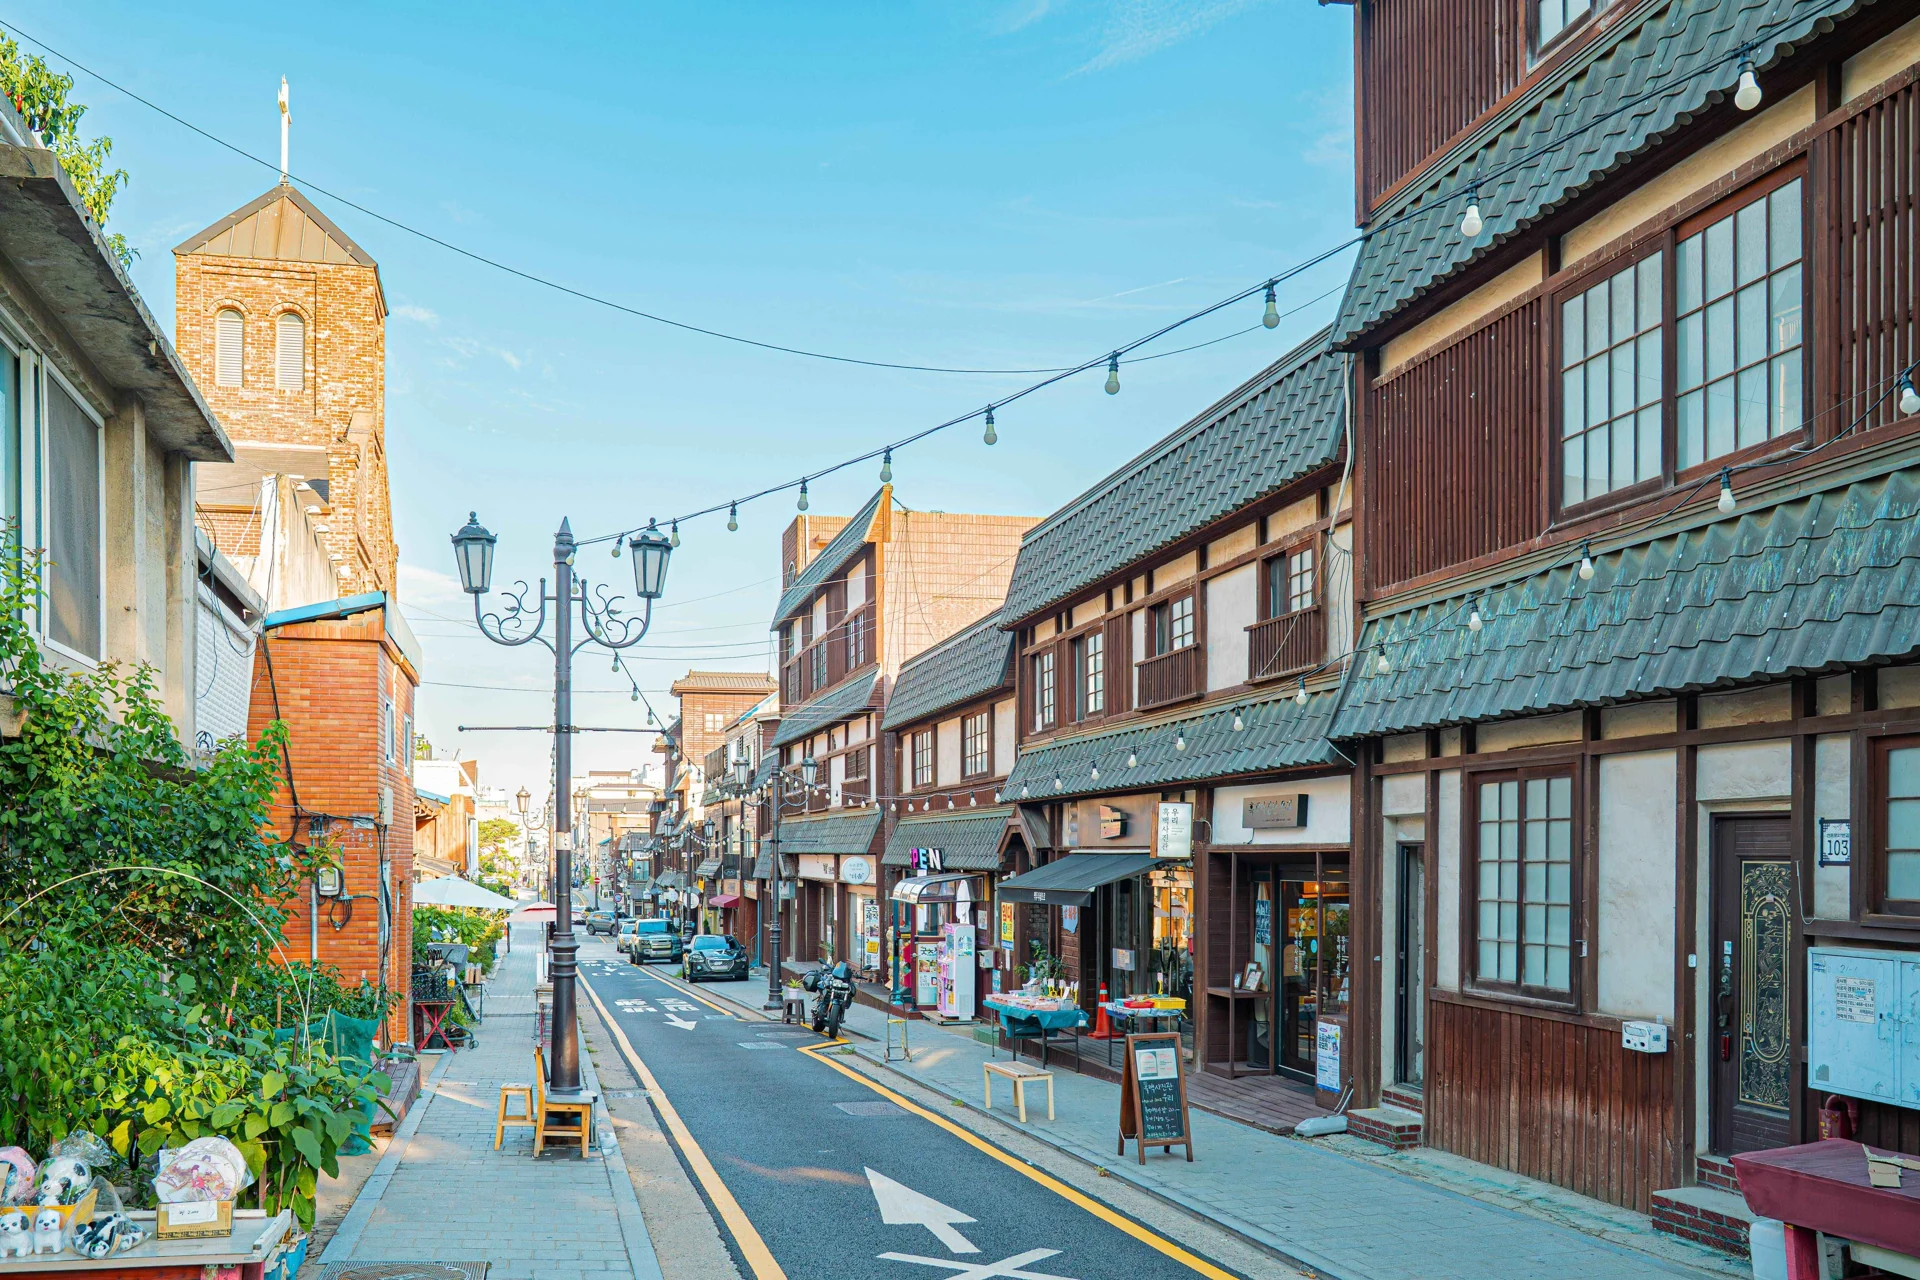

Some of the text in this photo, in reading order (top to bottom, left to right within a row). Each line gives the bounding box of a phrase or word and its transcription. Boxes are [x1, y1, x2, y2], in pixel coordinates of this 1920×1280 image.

[1171, 807, 1179, 825] 우리
[1827, 840, 1849, 856] 103
[1002, 904, 1013, 923] 임대
